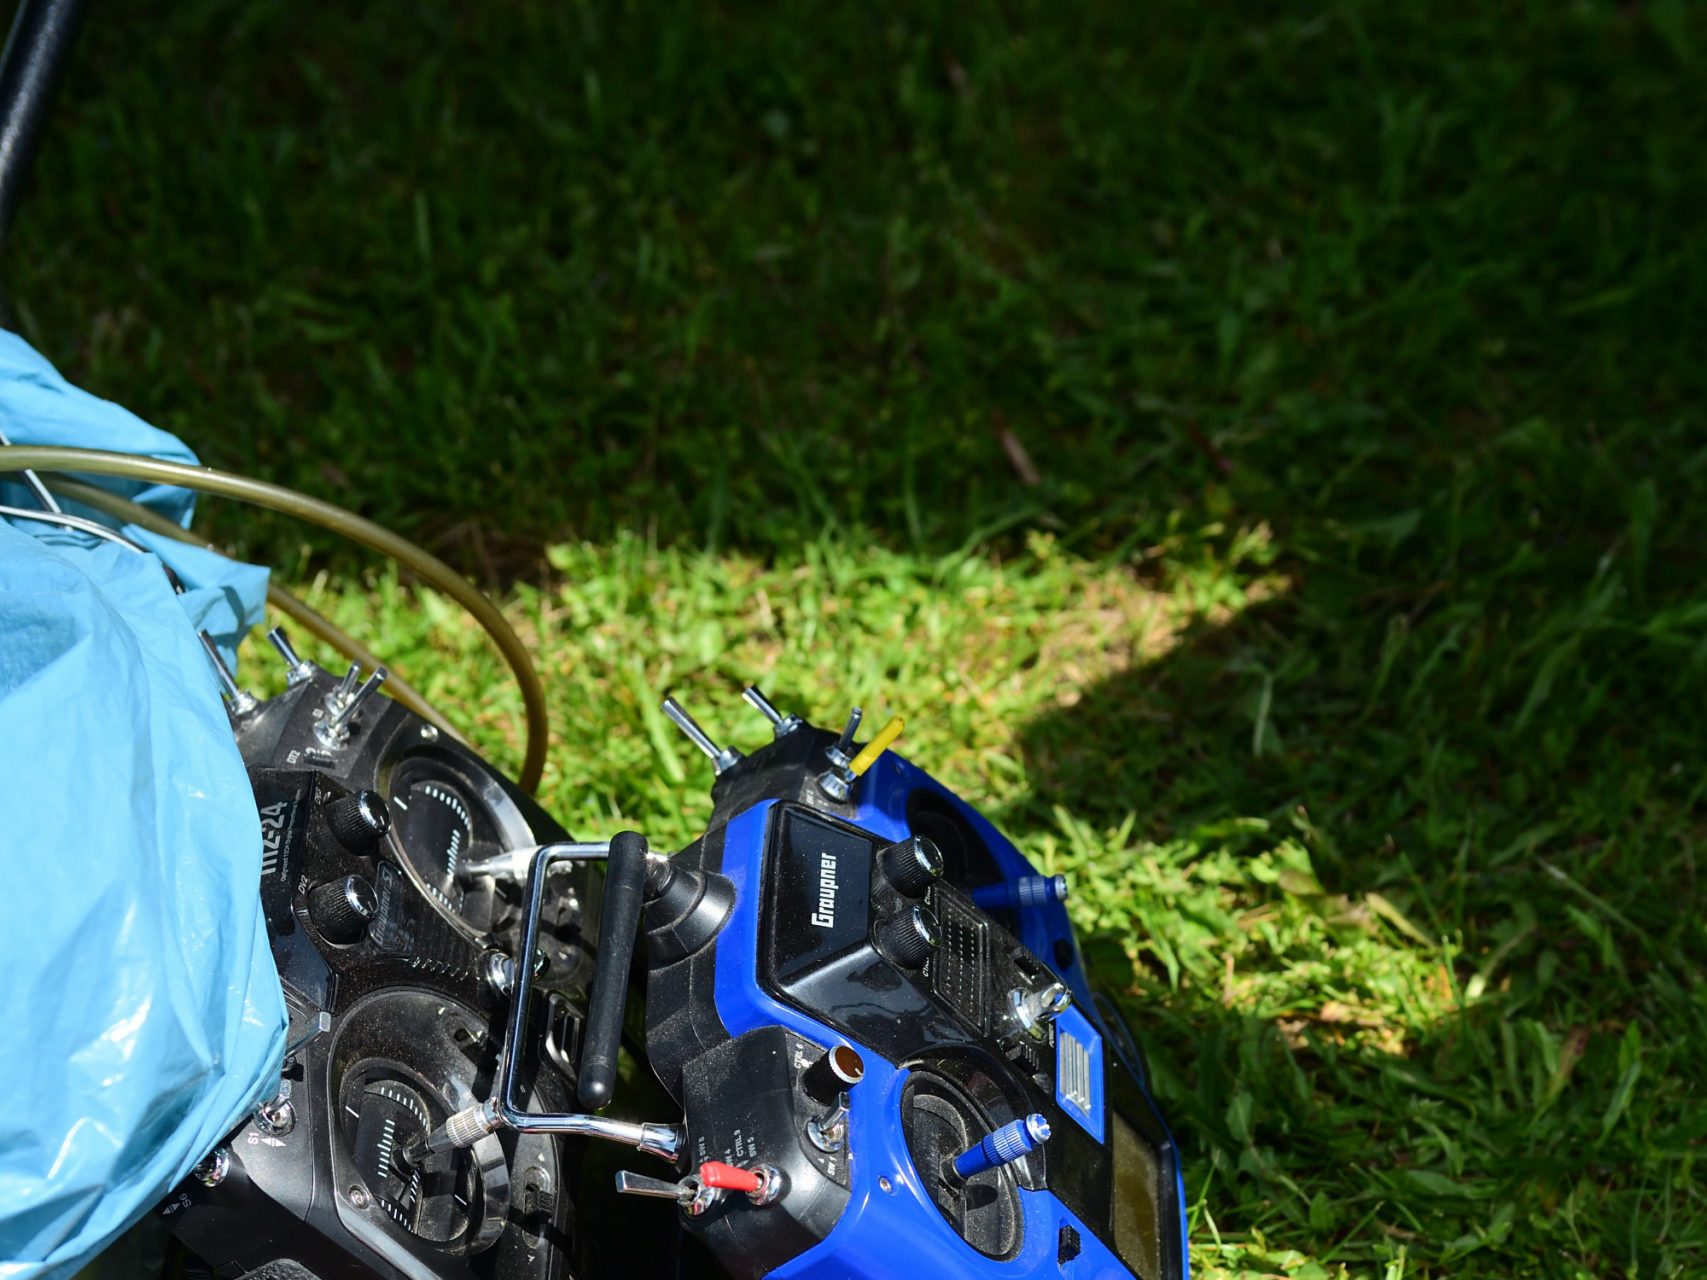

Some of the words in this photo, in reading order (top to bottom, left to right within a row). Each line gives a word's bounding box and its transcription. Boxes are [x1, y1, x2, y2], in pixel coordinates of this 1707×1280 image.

[298, 875, 308, 894] DV2
[811, 852, 839, 928] Graupner
[734, 1137, 743, 1157] CTRL
[748, 1144, 757, 1157] SW
